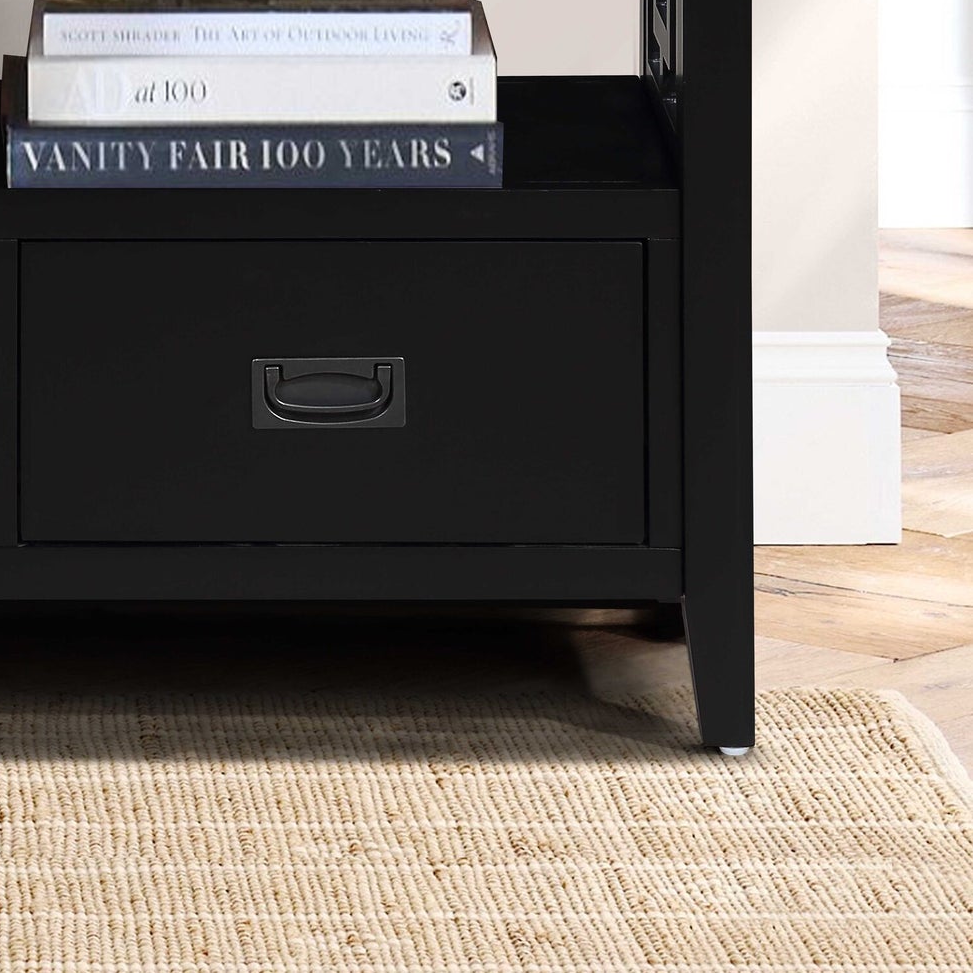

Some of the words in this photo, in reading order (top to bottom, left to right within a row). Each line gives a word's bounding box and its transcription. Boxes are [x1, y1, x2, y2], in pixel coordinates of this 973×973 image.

[134, 81, 156, 104] at
[164, 80, 208, 104] 100
[20, 141, 156, 171] VANITY
[169, 140, 251, 171] FAIR
[338, 137, 453, 170] YEARS
